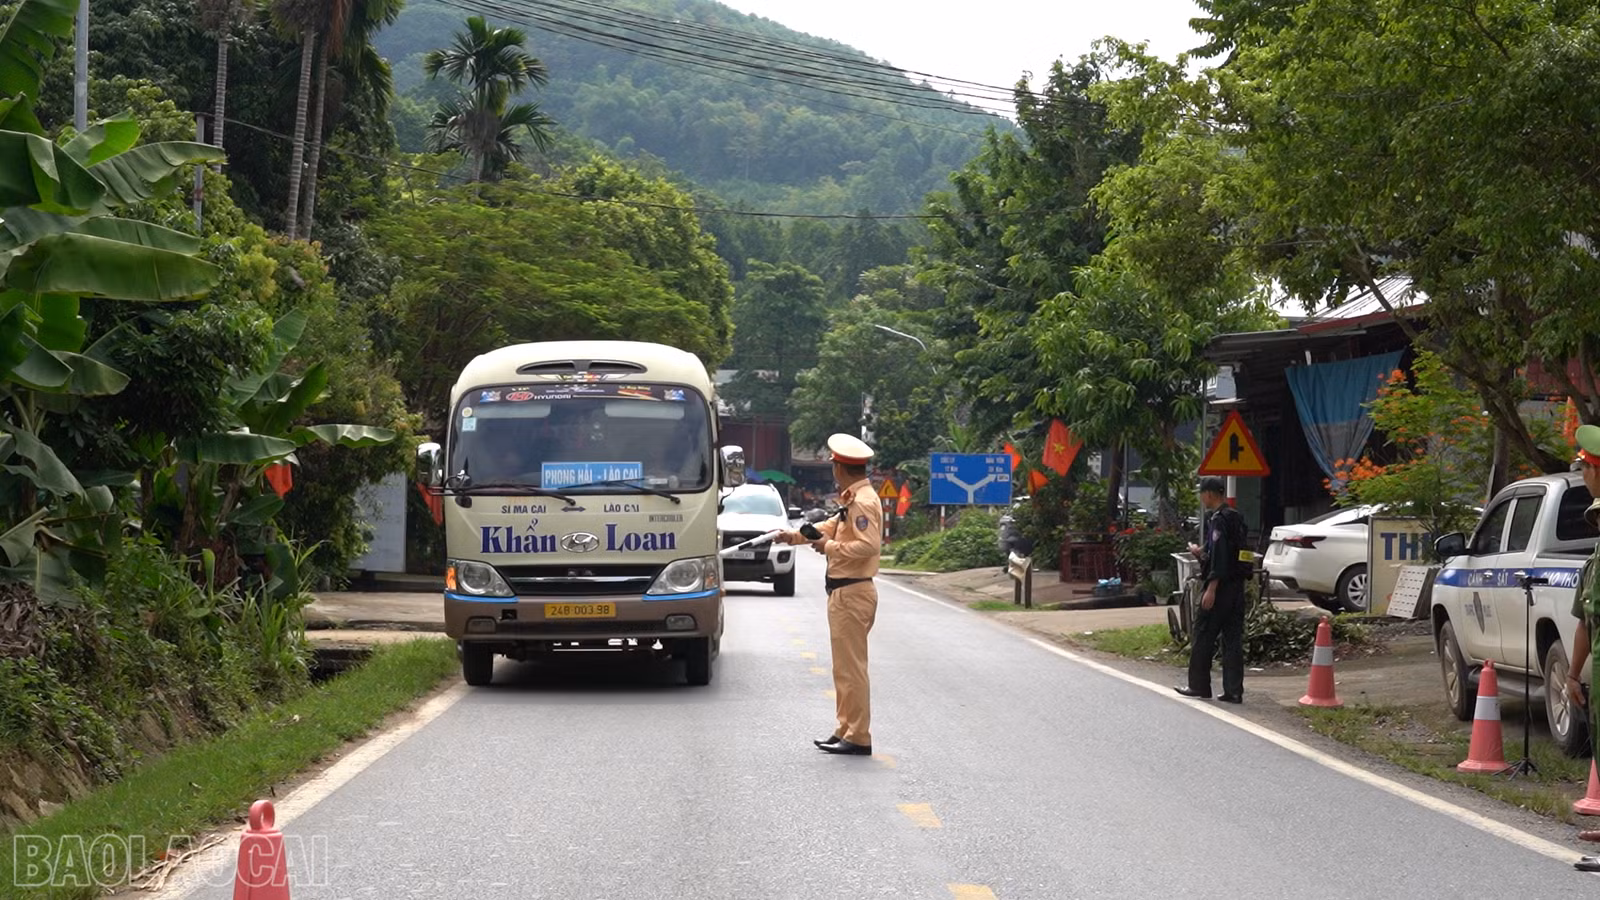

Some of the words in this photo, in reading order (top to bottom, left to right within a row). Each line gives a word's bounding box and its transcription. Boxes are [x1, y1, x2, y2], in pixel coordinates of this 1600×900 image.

[545, 469, 575, 485] PHONG
[513, 504, 528, 514] MA
[530, 504, 546, 513] CAI
[480, 518, 558, 554] Khẩn
[606, 524, 676, 553] Loan
